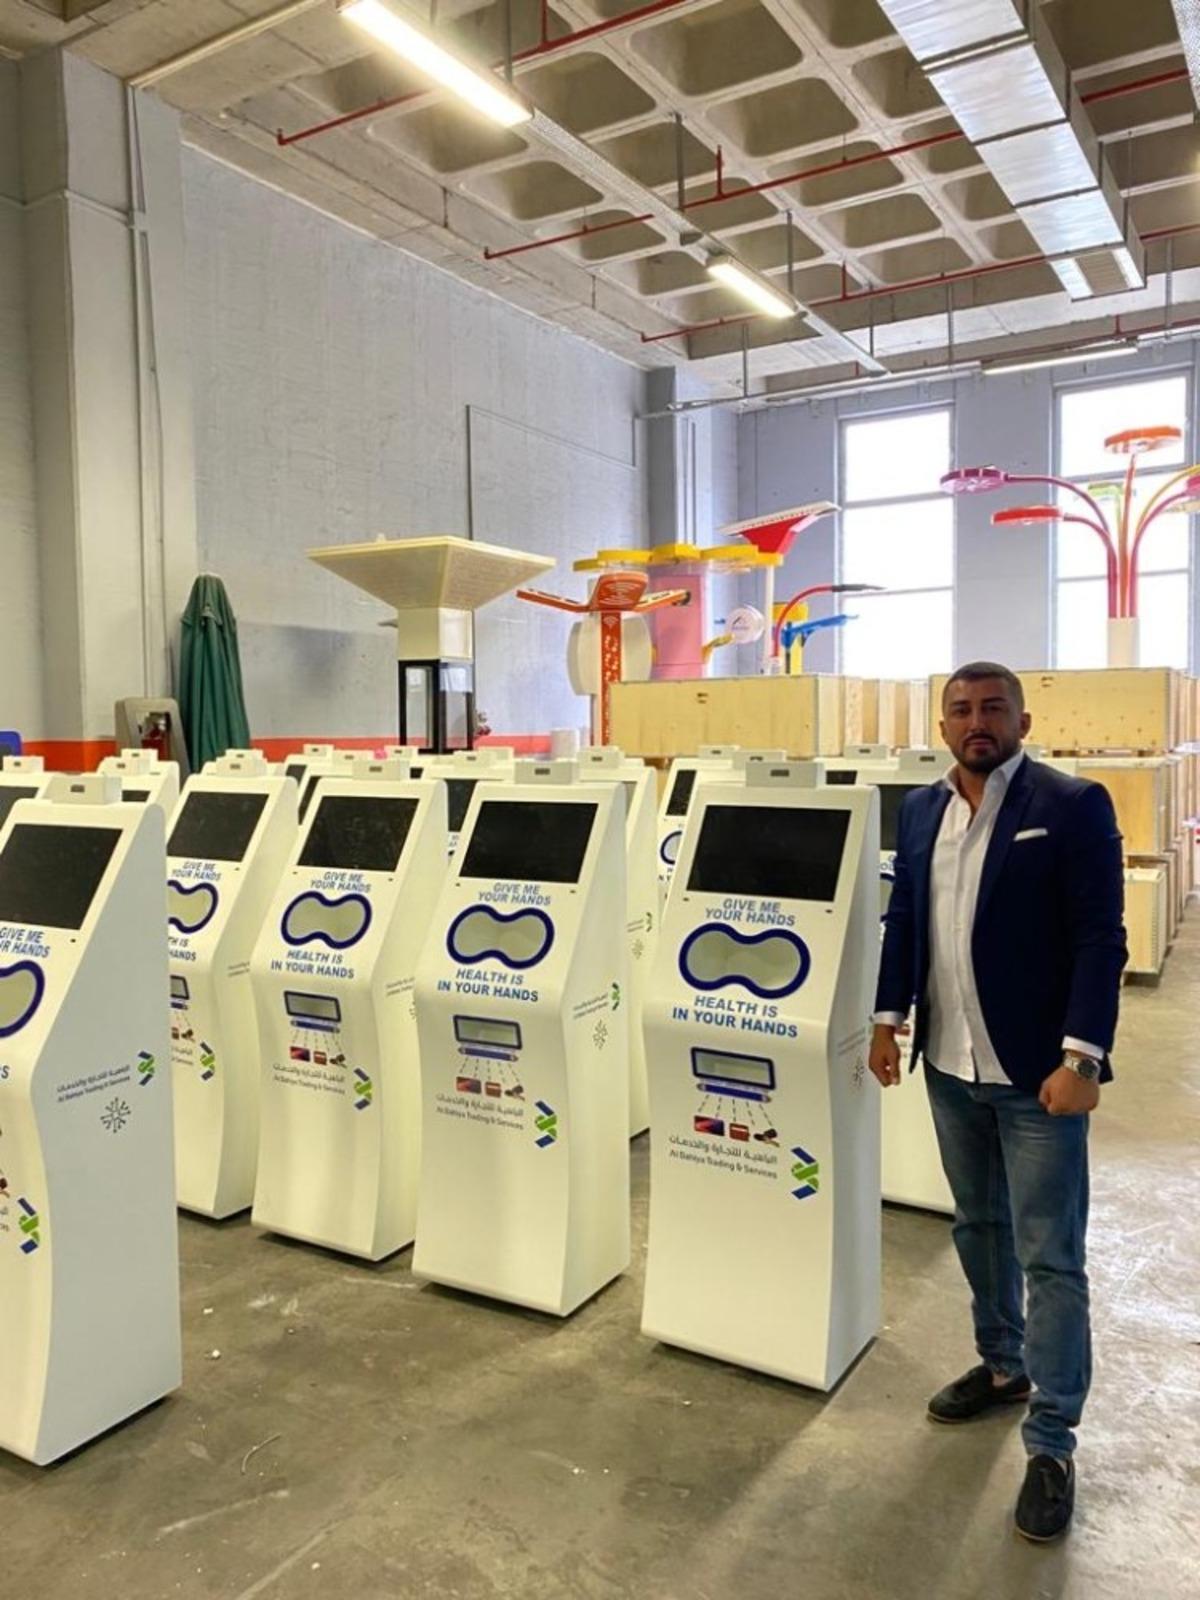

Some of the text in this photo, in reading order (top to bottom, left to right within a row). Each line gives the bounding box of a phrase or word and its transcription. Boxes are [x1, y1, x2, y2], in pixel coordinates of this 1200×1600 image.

[323, 871, 363, 882] GIVE ME
[310, 880, 371, 893] YOUR HANDS
[493, 882, 541, 895] GIVE ME
[478, 892, 552, 906] YOUR HANDS
[723, 898, 781, 913] GIVE ME
[705, 908, 795, 927] YOUR HANDS
[0, 926, 45, 943] GIVE ME
[11, 942, 50, 958] HANDS
[286, 949, 343, 965] HEALTH IS
[271, 960, 355, 979] IN YOUR HANDS
[456, 968, 524, 985] HEALTH IS
[437, 980, 539, 1002] IN YOUR HANDS
[694, 995, 778, 1018] HEALTH IS
[672, 1007, 798, 1038] IN YOUR HANDS
[707, 1156, 735, 1171] Trading
